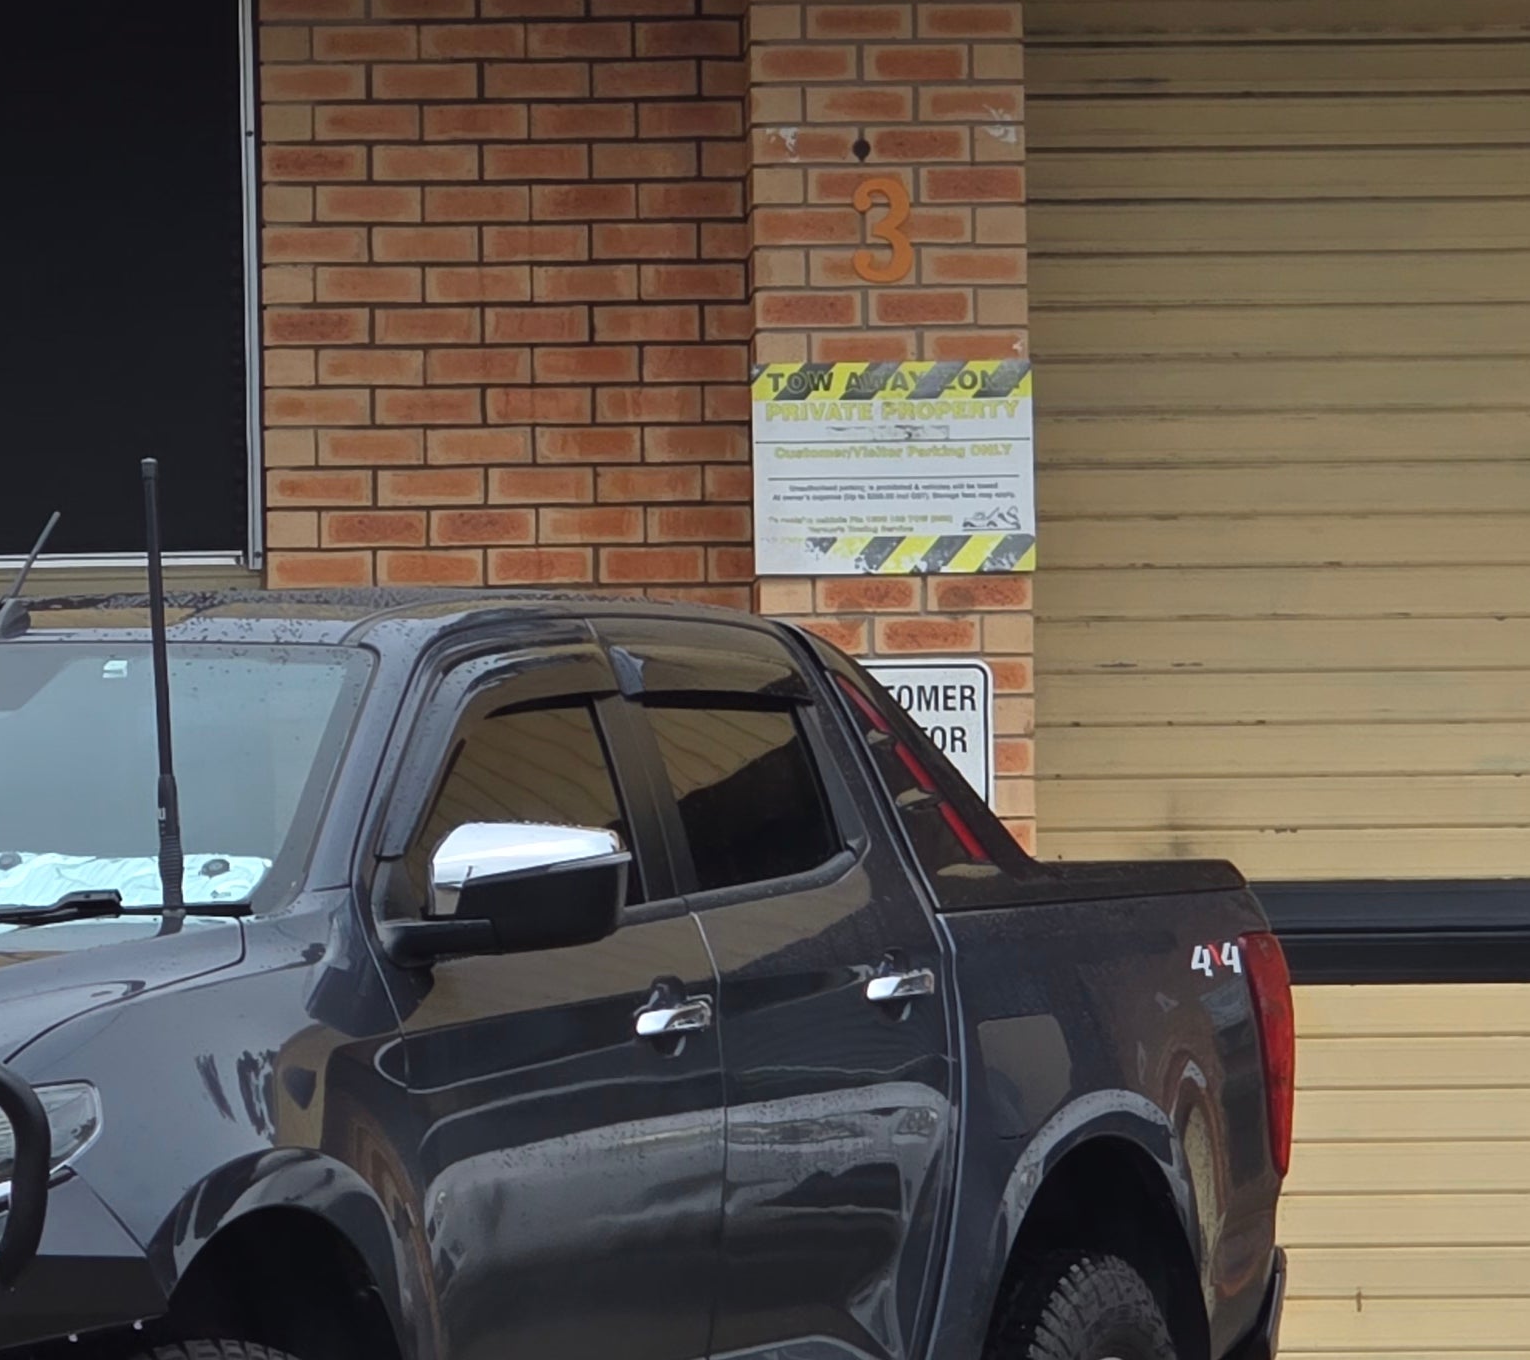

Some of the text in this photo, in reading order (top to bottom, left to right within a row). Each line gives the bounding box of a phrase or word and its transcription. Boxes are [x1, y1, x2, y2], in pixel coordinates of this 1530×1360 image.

[852, 177, 913, 283] 3
[766, 371, 834, 394] TOW
[765, 400, 1020, 421] PRIVATE PROPERTY
[906, 444, 966, 458] Parking
[971, 443, 1013, 456] ONLY
